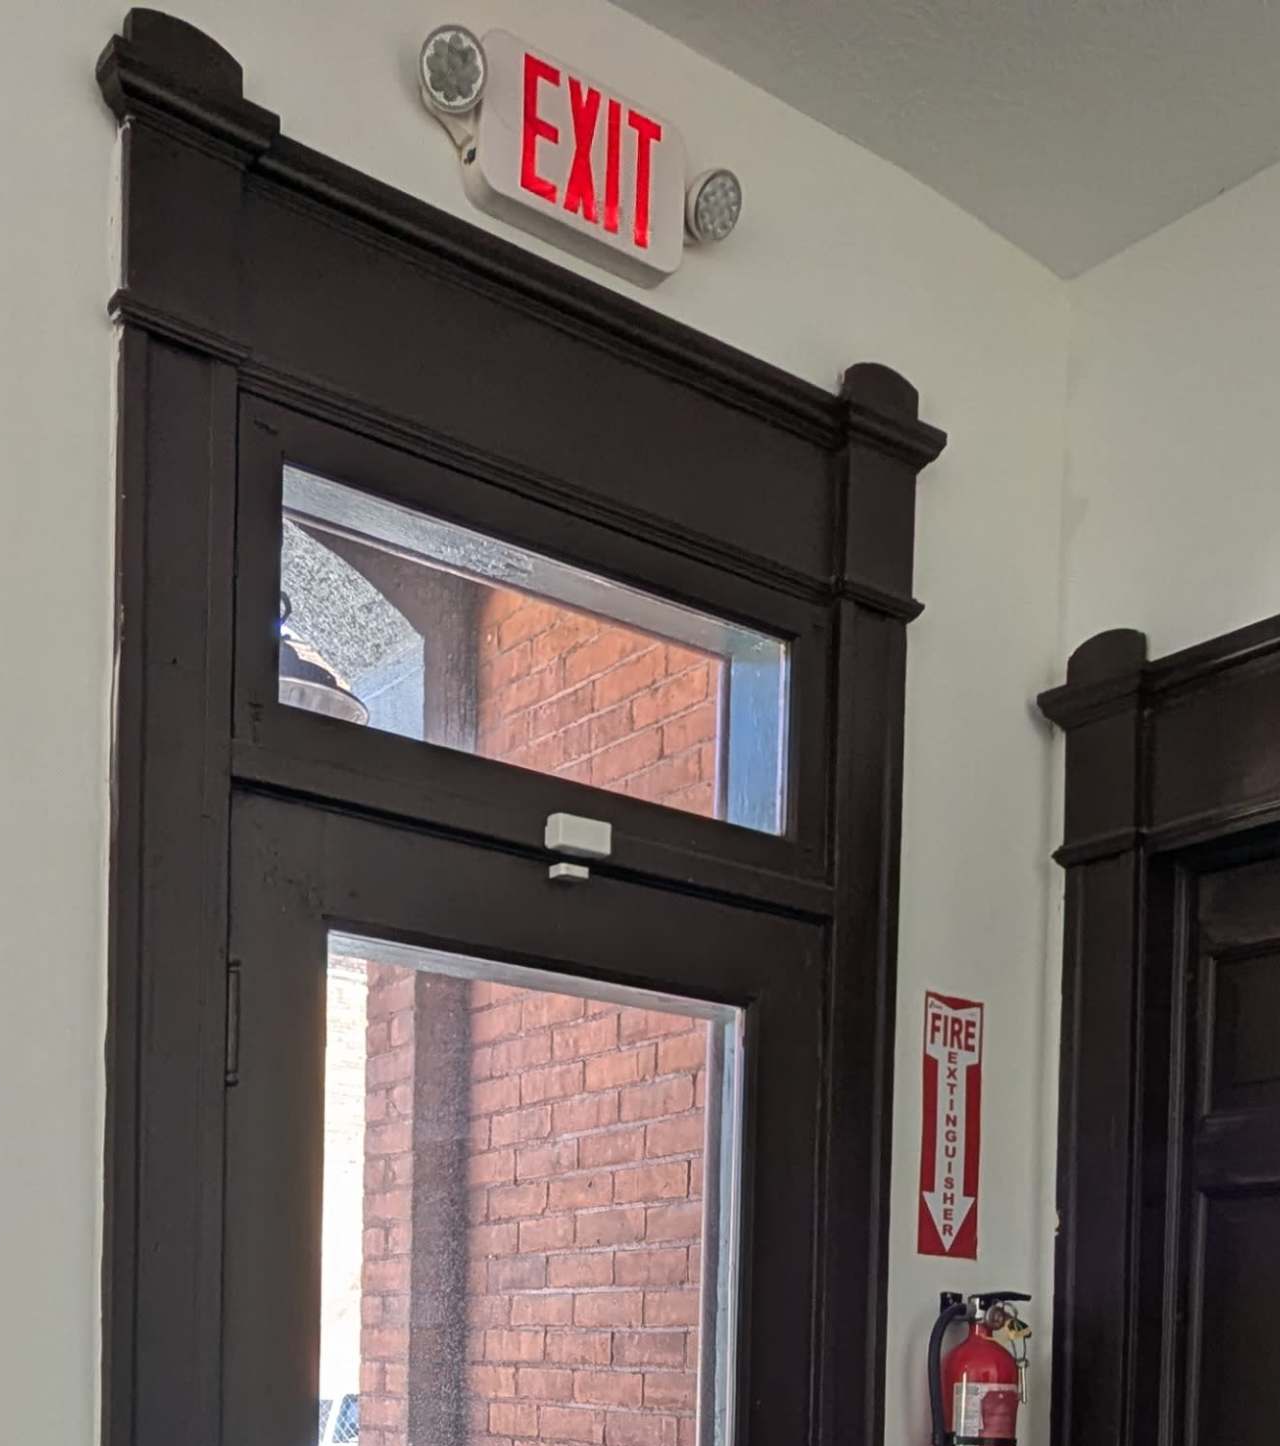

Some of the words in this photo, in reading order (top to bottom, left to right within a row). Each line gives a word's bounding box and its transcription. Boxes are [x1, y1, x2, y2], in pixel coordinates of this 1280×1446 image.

[520, 52, 662, 249] EXIT
[930, 1012, 976, 1053] FIRE
[942, 1051, 958, 1237] EXTINGUISHER
